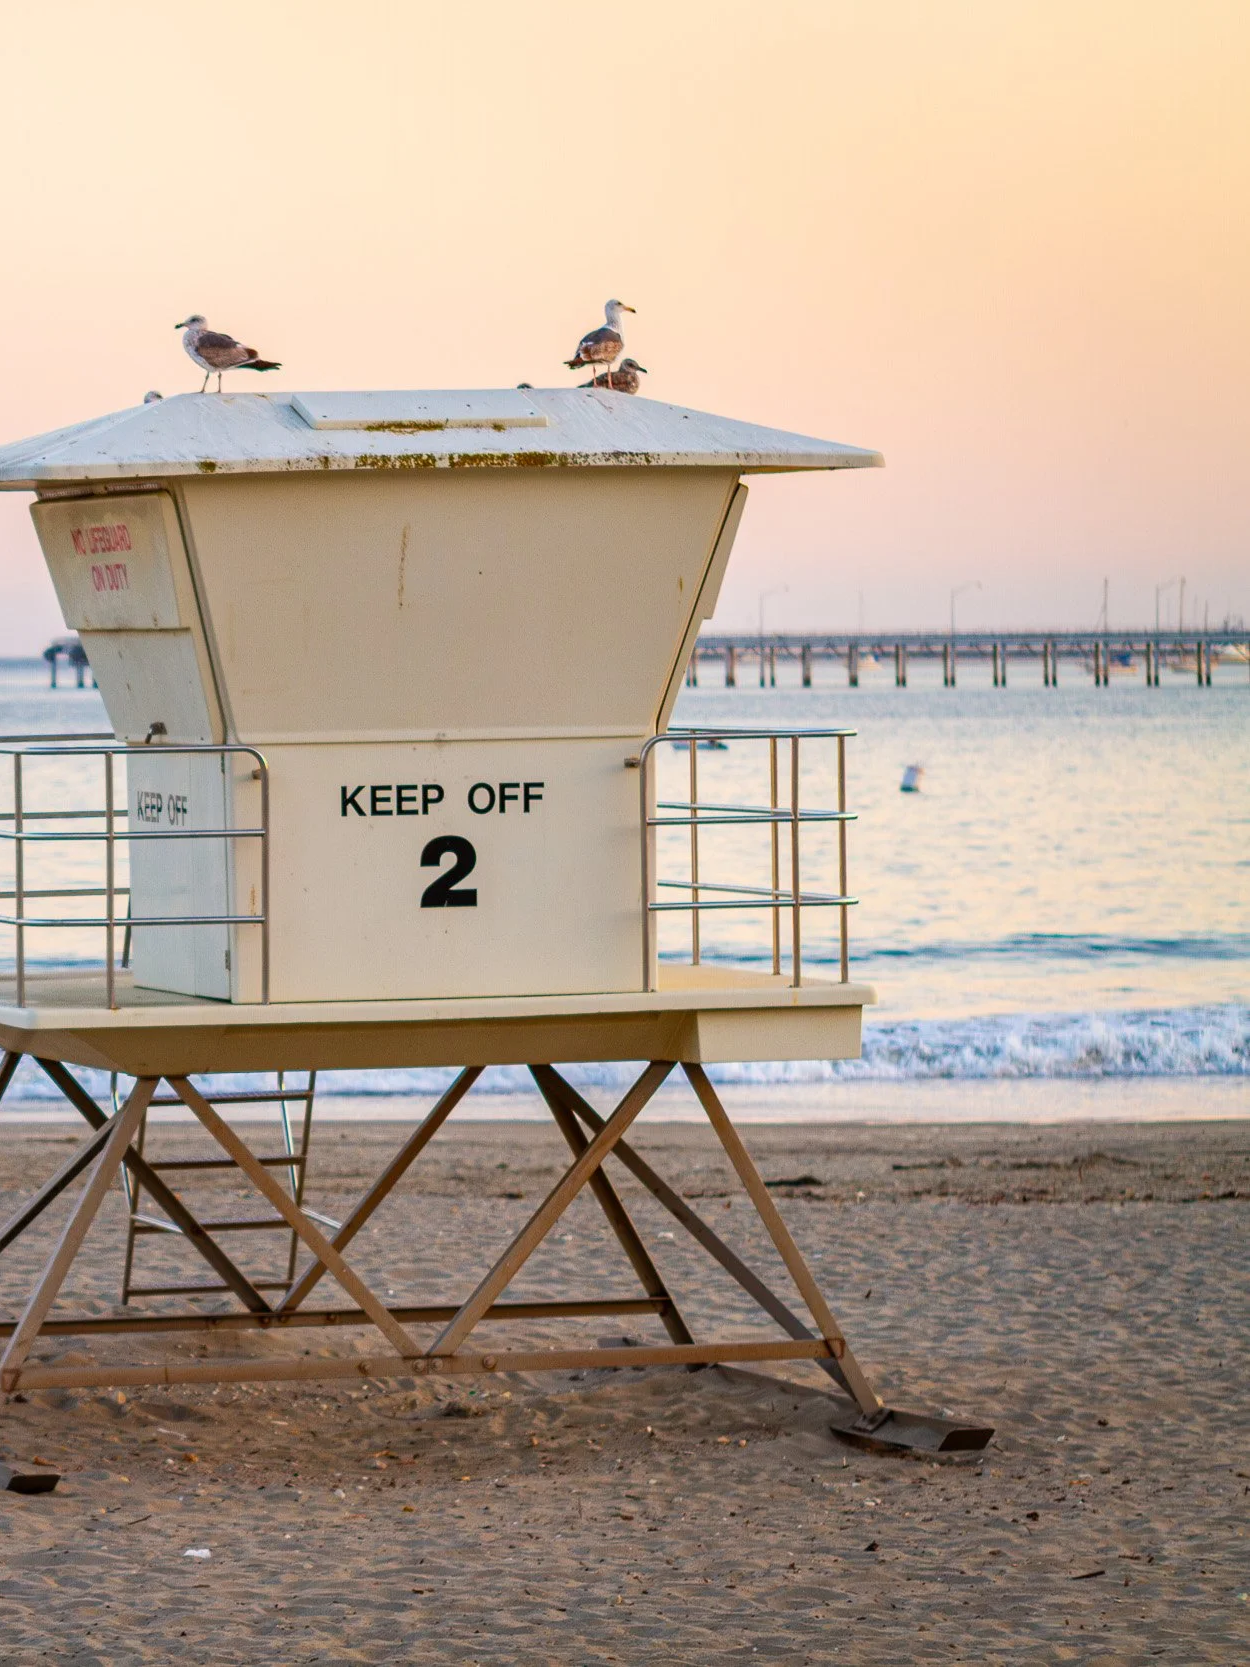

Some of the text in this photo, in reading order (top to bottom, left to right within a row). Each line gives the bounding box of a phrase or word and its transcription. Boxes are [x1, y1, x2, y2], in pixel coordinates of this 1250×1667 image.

[70, 524, 132, 556] NO LIFEGUARD
[91, 564, 129, 592] ON DUTY
[137, 791, 187, 826] KEEP OFF
[340, 782, 545, 817] KEEP OFF
[420, 835, 478, 908] 2
